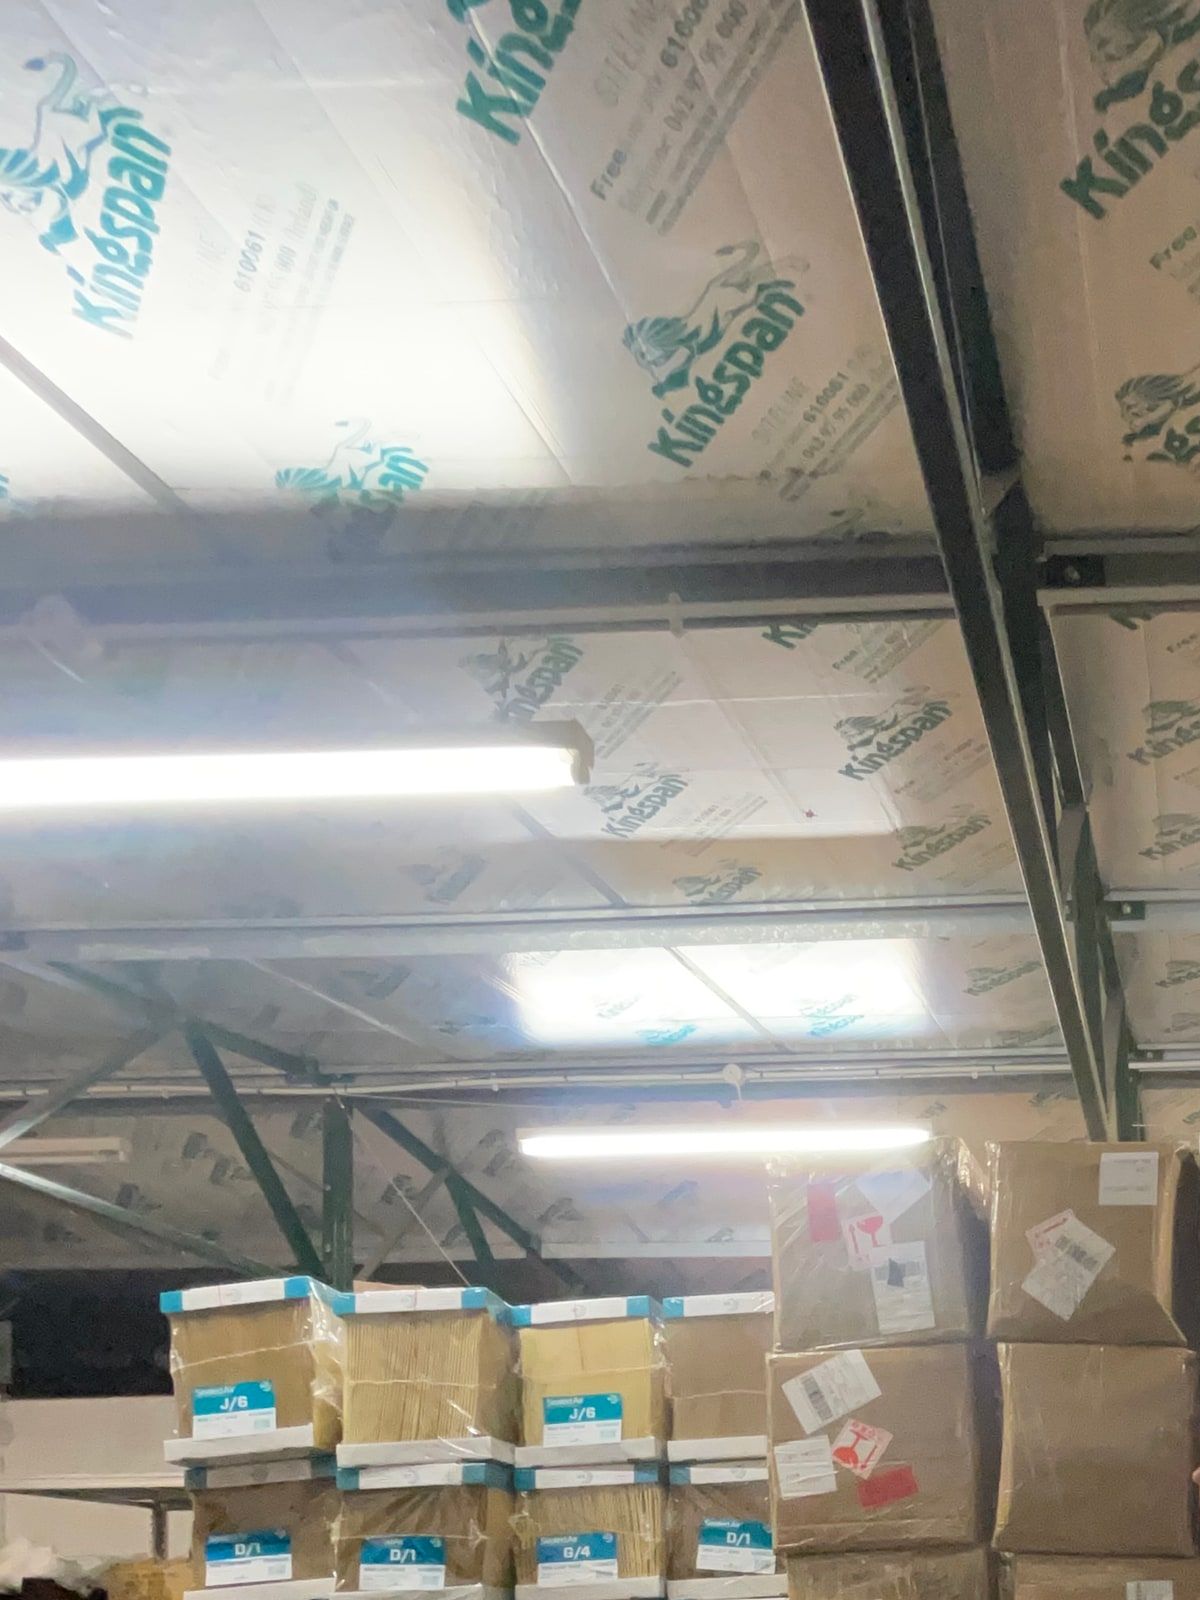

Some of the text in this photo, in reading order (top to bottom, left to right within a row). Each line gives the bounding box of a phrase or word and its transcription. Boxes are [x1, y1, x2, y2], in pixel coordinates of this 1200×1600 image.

[456, 0, 583, 145] King
[72, 121, 171, 339] Kingspan
[648, 291, 805, 468] Kingspan
[838, 704, 953, 781] Kingspan
[601, 775, 689, 839] Kingspan
[891, 814, 992, 872] Kingspan
[220, 1396, 248, 1411] J/6
[569, 1407, 596, 1420] J/6
[390, 1547, 416, 1562] D/1
[726, 1531, 750, 1546] D/1
